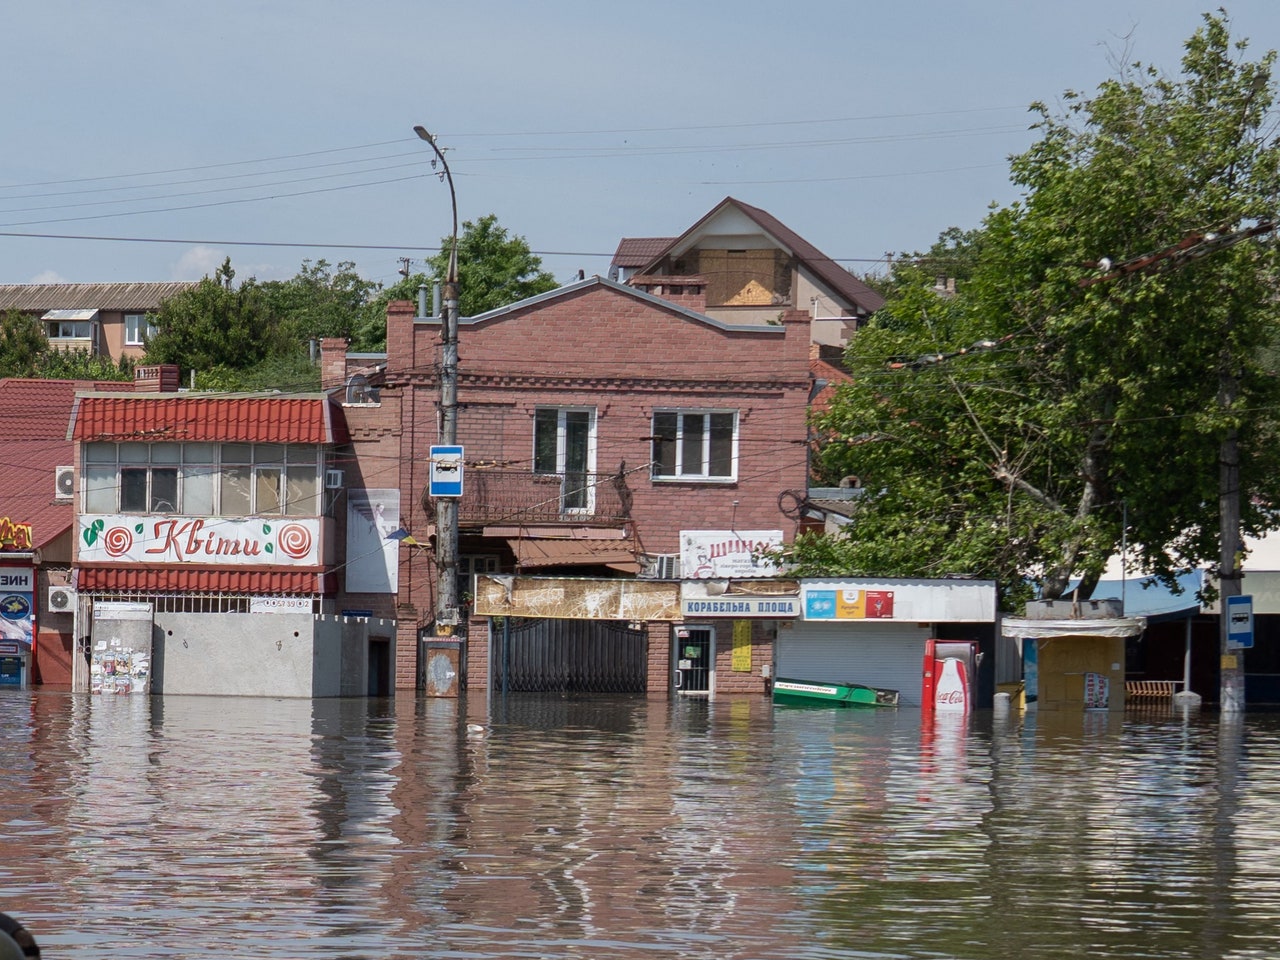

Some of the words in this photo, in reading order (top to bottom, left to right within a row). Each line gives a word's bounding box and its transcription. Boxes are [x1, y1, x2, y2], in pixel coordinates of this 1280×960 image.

[145, 519, 261, 562] Квіти
[687, 602, 751, 612] КОРАБЕЛЬНА
[758, 602, 794, 613] ПЛОЩА
